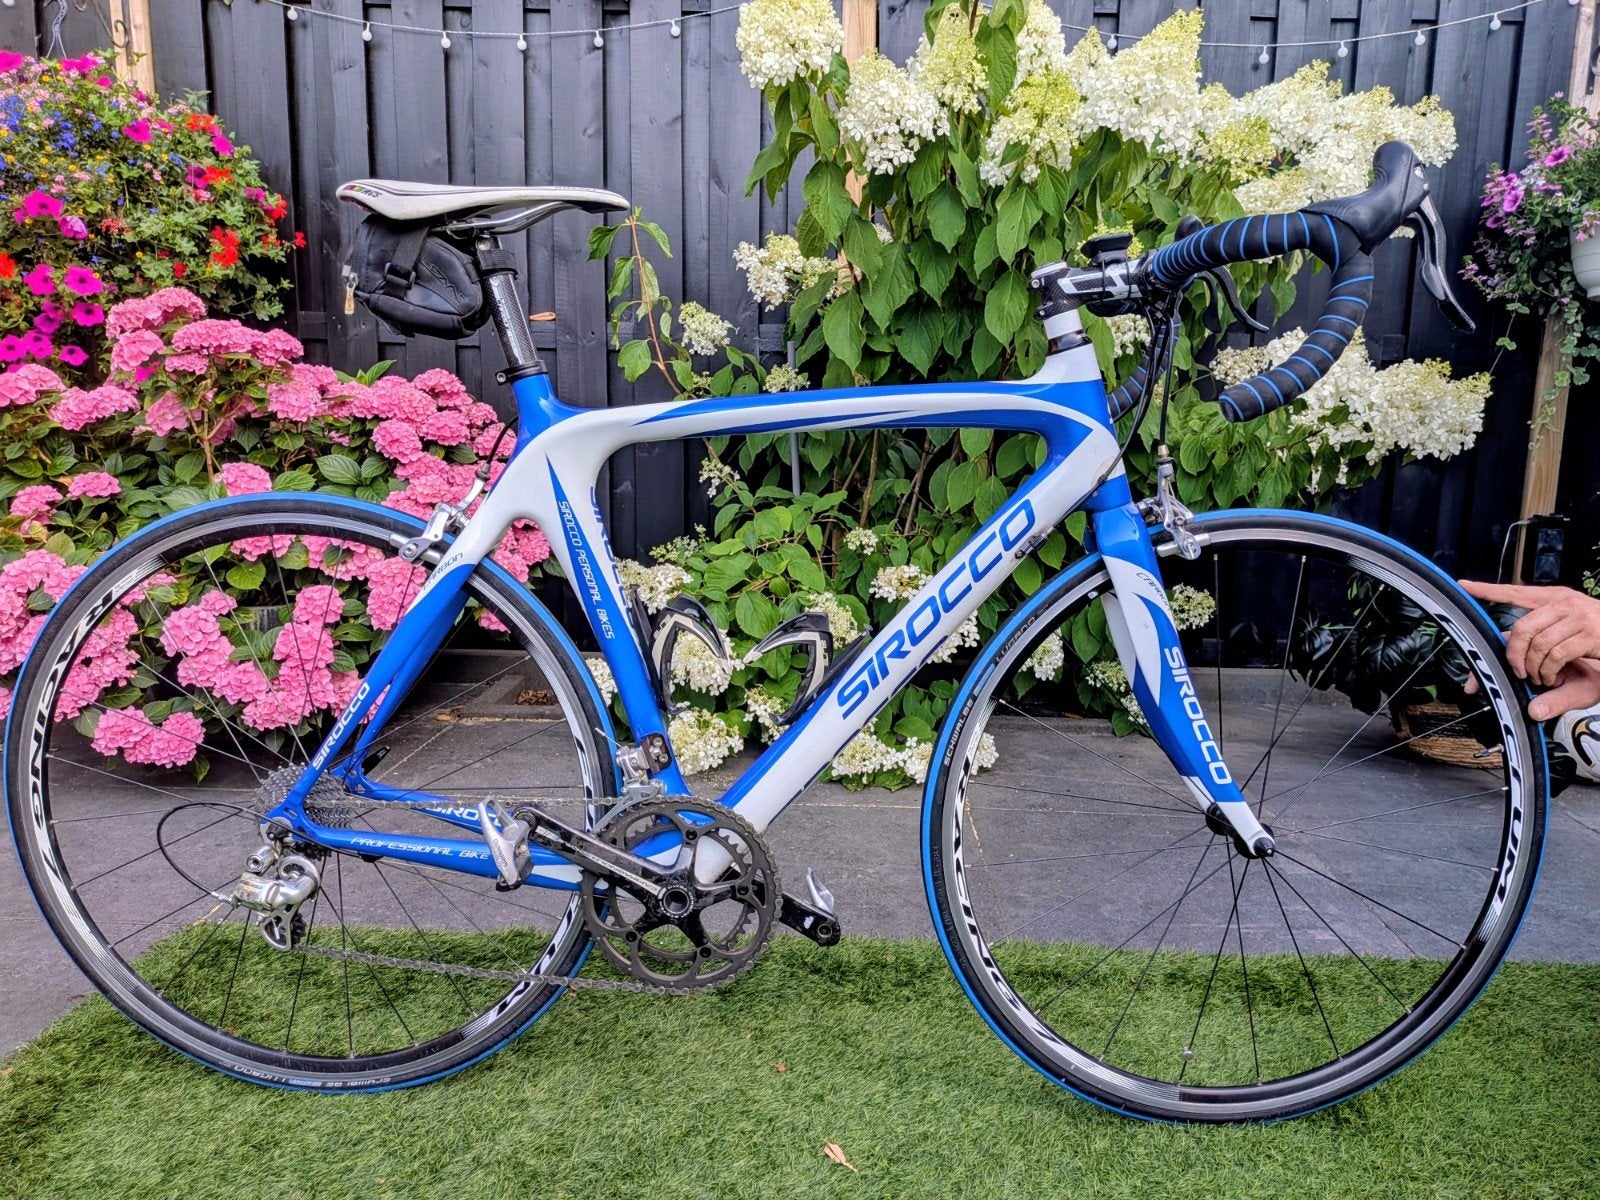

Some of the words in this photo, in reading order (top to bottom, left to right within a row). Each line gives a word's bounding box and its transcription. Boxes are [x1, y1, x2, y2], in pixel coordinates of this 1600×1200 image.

[559, 501, 582, 546] SIROCCO
[577, 548, 602, 604] PERSONAL
[597, 608, 615, 639] BIKES
[836, 499, 1036, 720] SIROCCO
[312, 682, 370, 771] SIROCCO
[944, 699, 974, 767] SCHWALBE
[1164, 646, 1232, 785] SIROCCO
[1435, 613, 1523, 904] FULCRUM
[351, 837, 453, 856] PROFESSIONAL
[458, 850, 491, 860] BIKE
[953, 756, 1022, 1011] RACING
